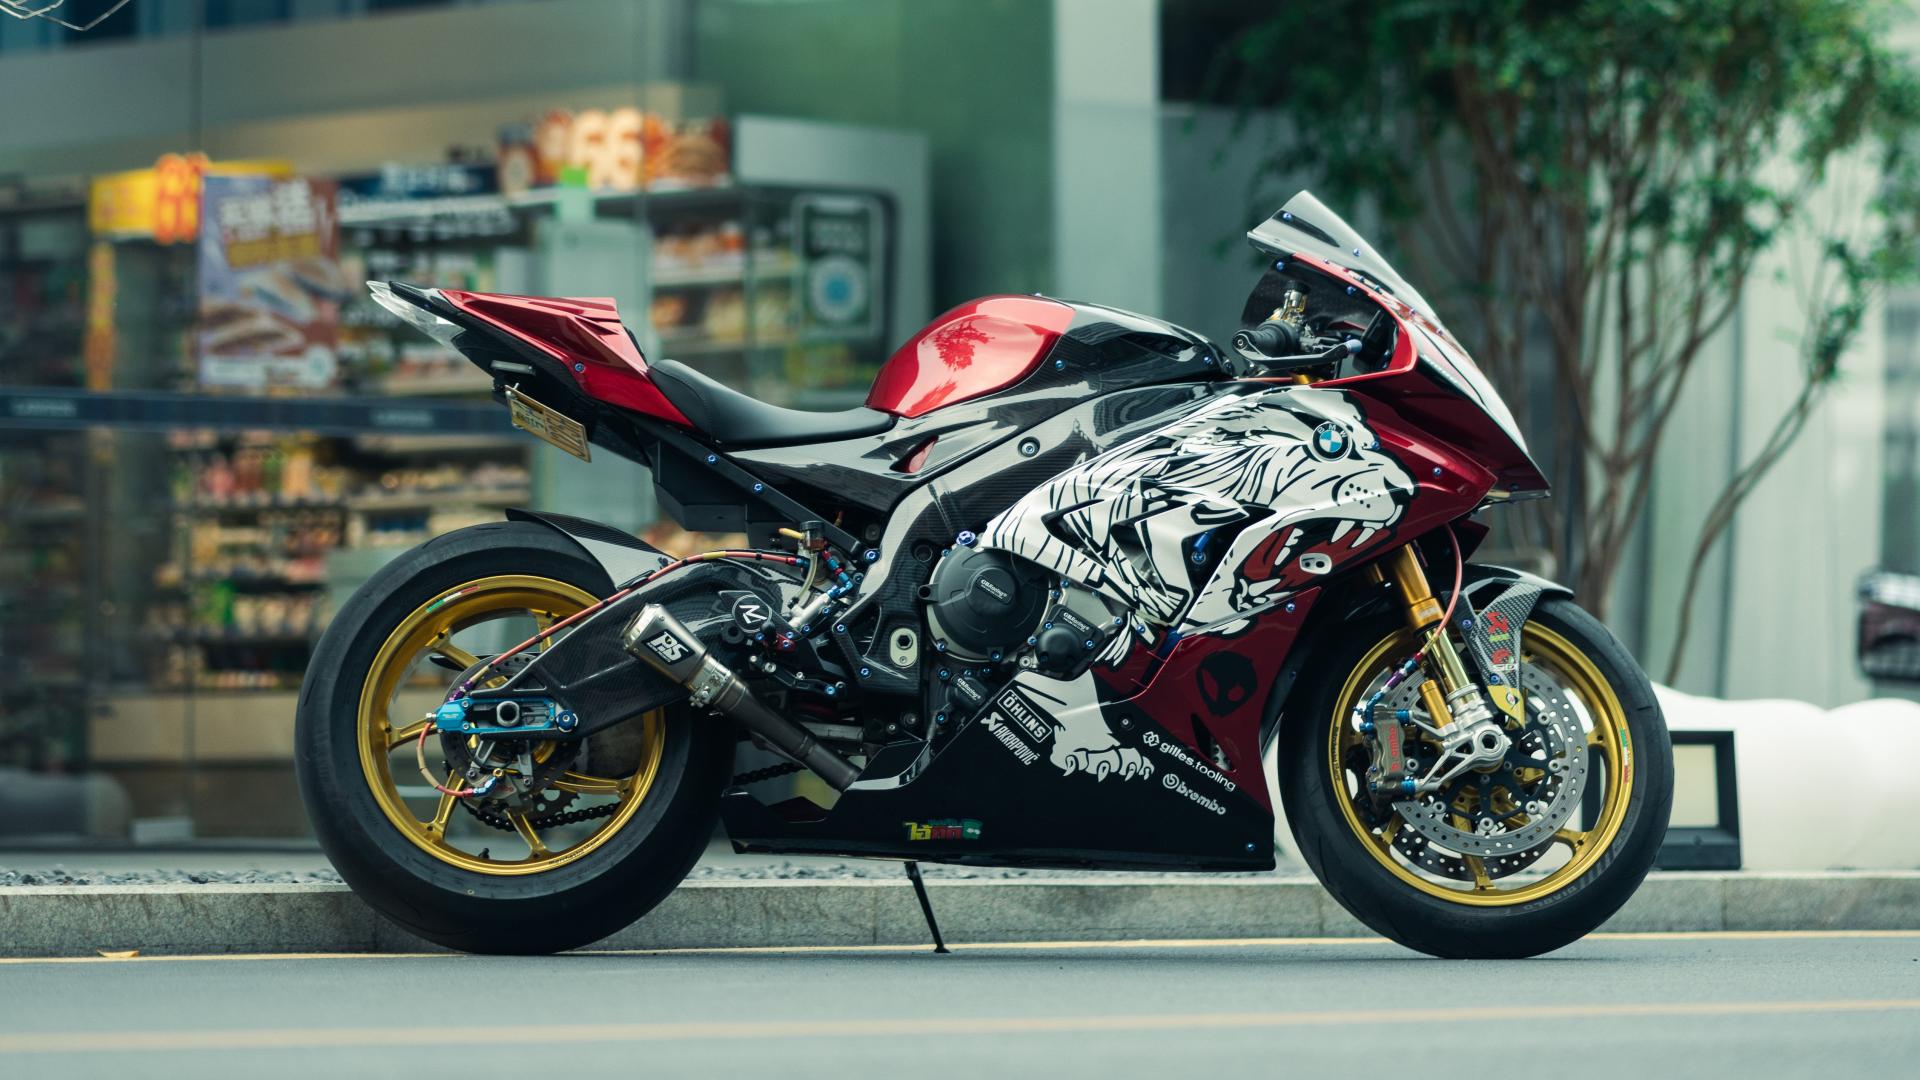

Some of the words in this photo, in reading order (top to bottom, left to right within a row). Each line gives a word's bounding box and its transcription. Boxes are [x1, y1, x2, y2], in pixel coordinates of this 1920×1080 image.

[1317, 423, 1348, 438] BMW
[1003, 693, 1047, 738] ÖHLINS
[1159, 742, 1237, 792] gilles.tooling
[1175, 781, 1227, 815] brembo
